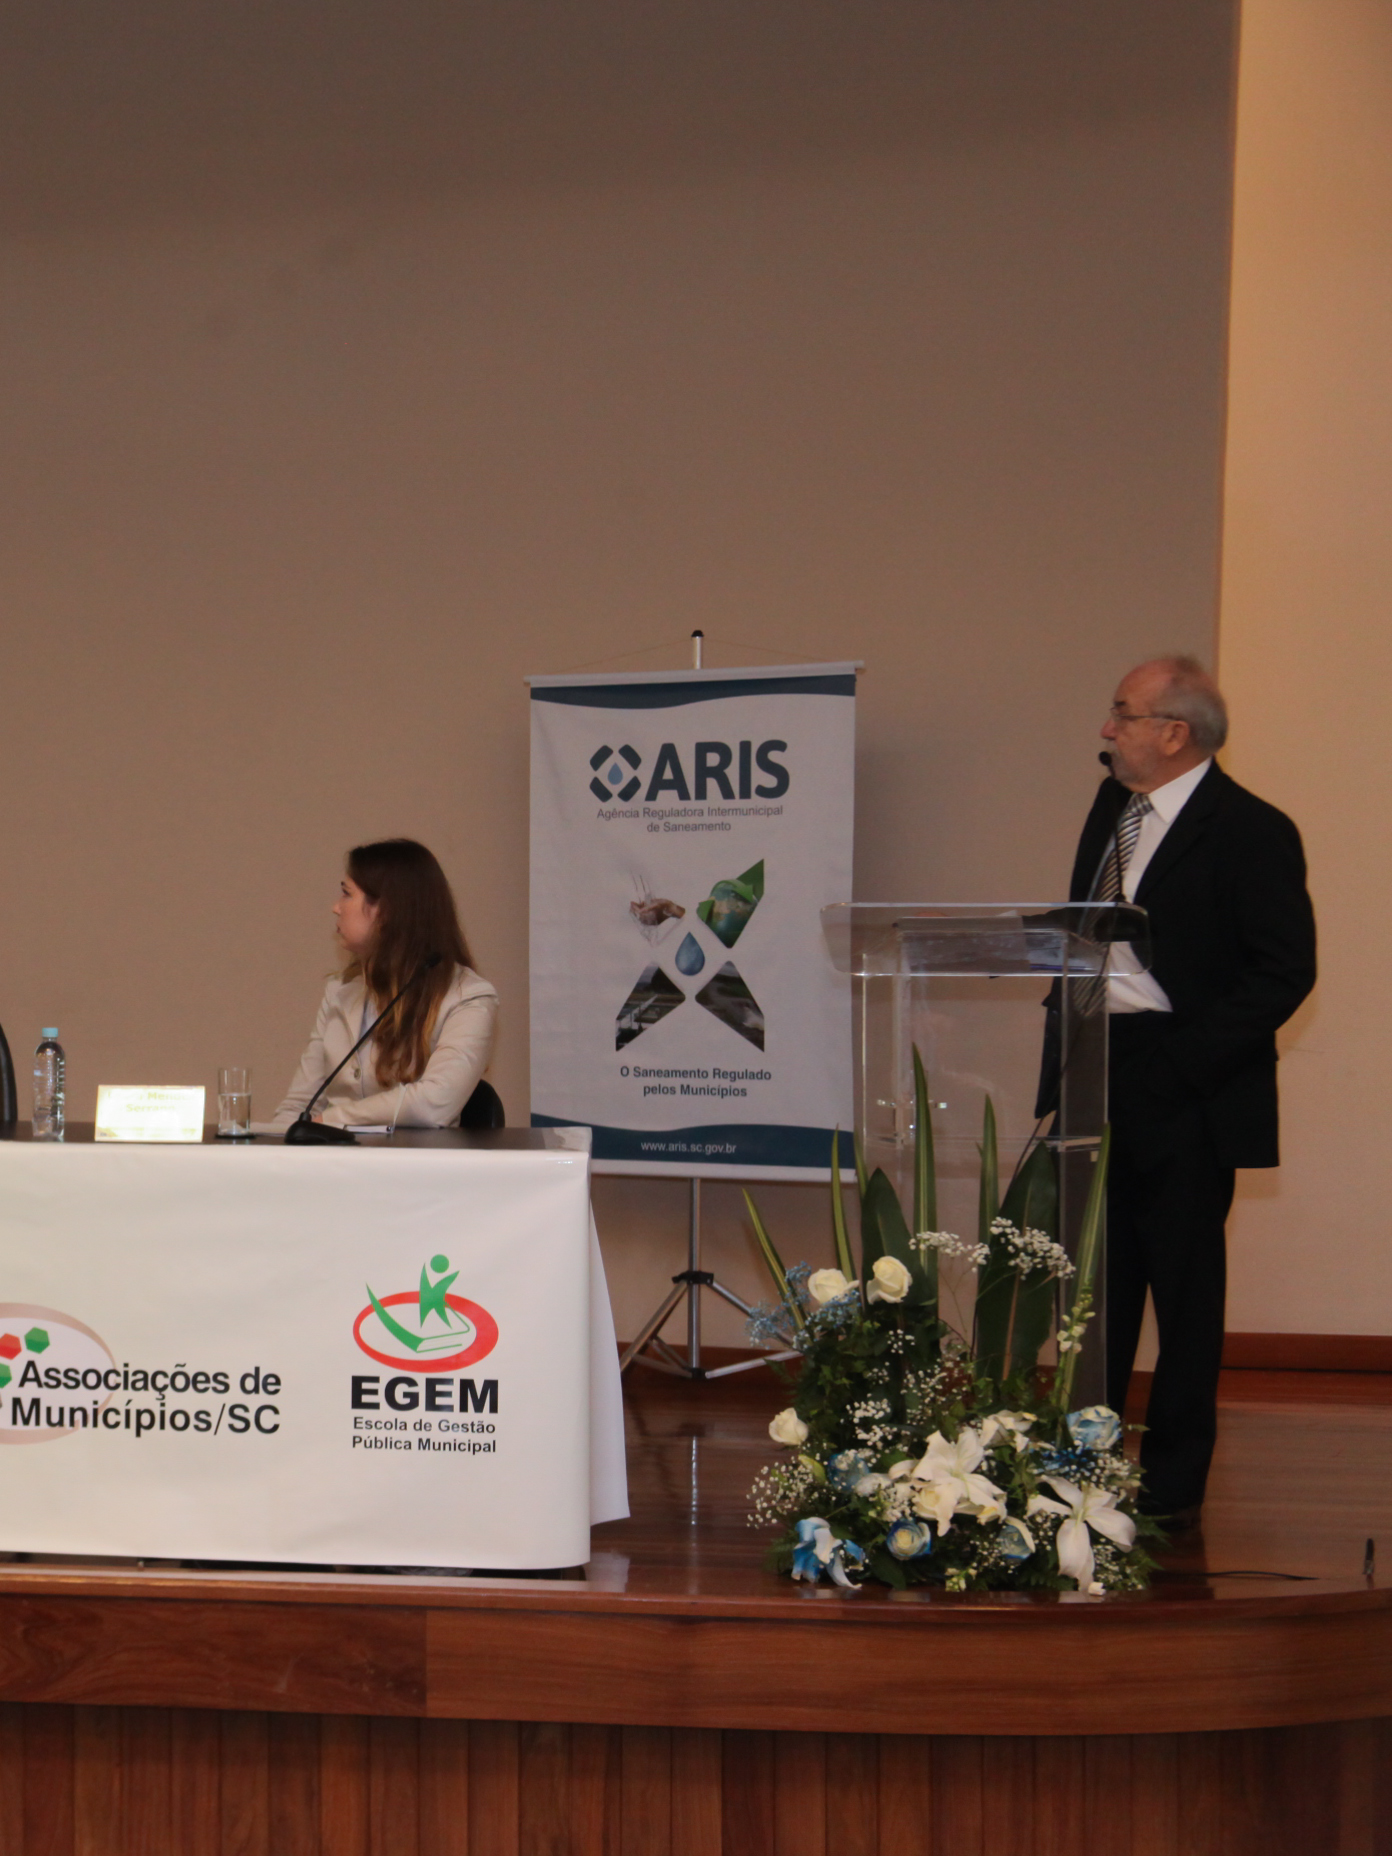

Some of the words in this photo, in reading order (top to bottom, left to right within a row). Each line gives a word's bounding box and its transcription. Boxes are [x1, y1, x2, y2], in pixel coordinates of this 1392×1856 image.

[645, 739, 790, 801] ARIS
[597, 807, 639, 821] Agência
[643, 806, 704, 820] Reguladora
[707, 805, 783, 819] Intermunicipal
[647, 822, 660, 832] de
[663, 821, 731, 832] Saneamento
[620, 1066, 630, 1077] O
[633, 1066, 709, 1079] Saneamento
[713, 1068, 772, 1082] Regulado
[643, 1084, 676, 1097] pelos
[680, 1084, 747, 1099] Municípios
[641, 1141, 737, 1155] www.aris.sc.gov.br
[18, 1360, 230, 1400] Associações
[239, 1366, 281, 1395] de
[351, 1375, 498, 1414] EGEM
[11, 1397, 280, 1438] Municípios/SC
[353, 1416, 407, 1431] Escola
[413, 1418, 432, 1432] de
[438, 1419, 496, 1434] Gestão
[352, 1435, 412, 1450] Pública
[418, 1437, 496, 1455] Municipal
